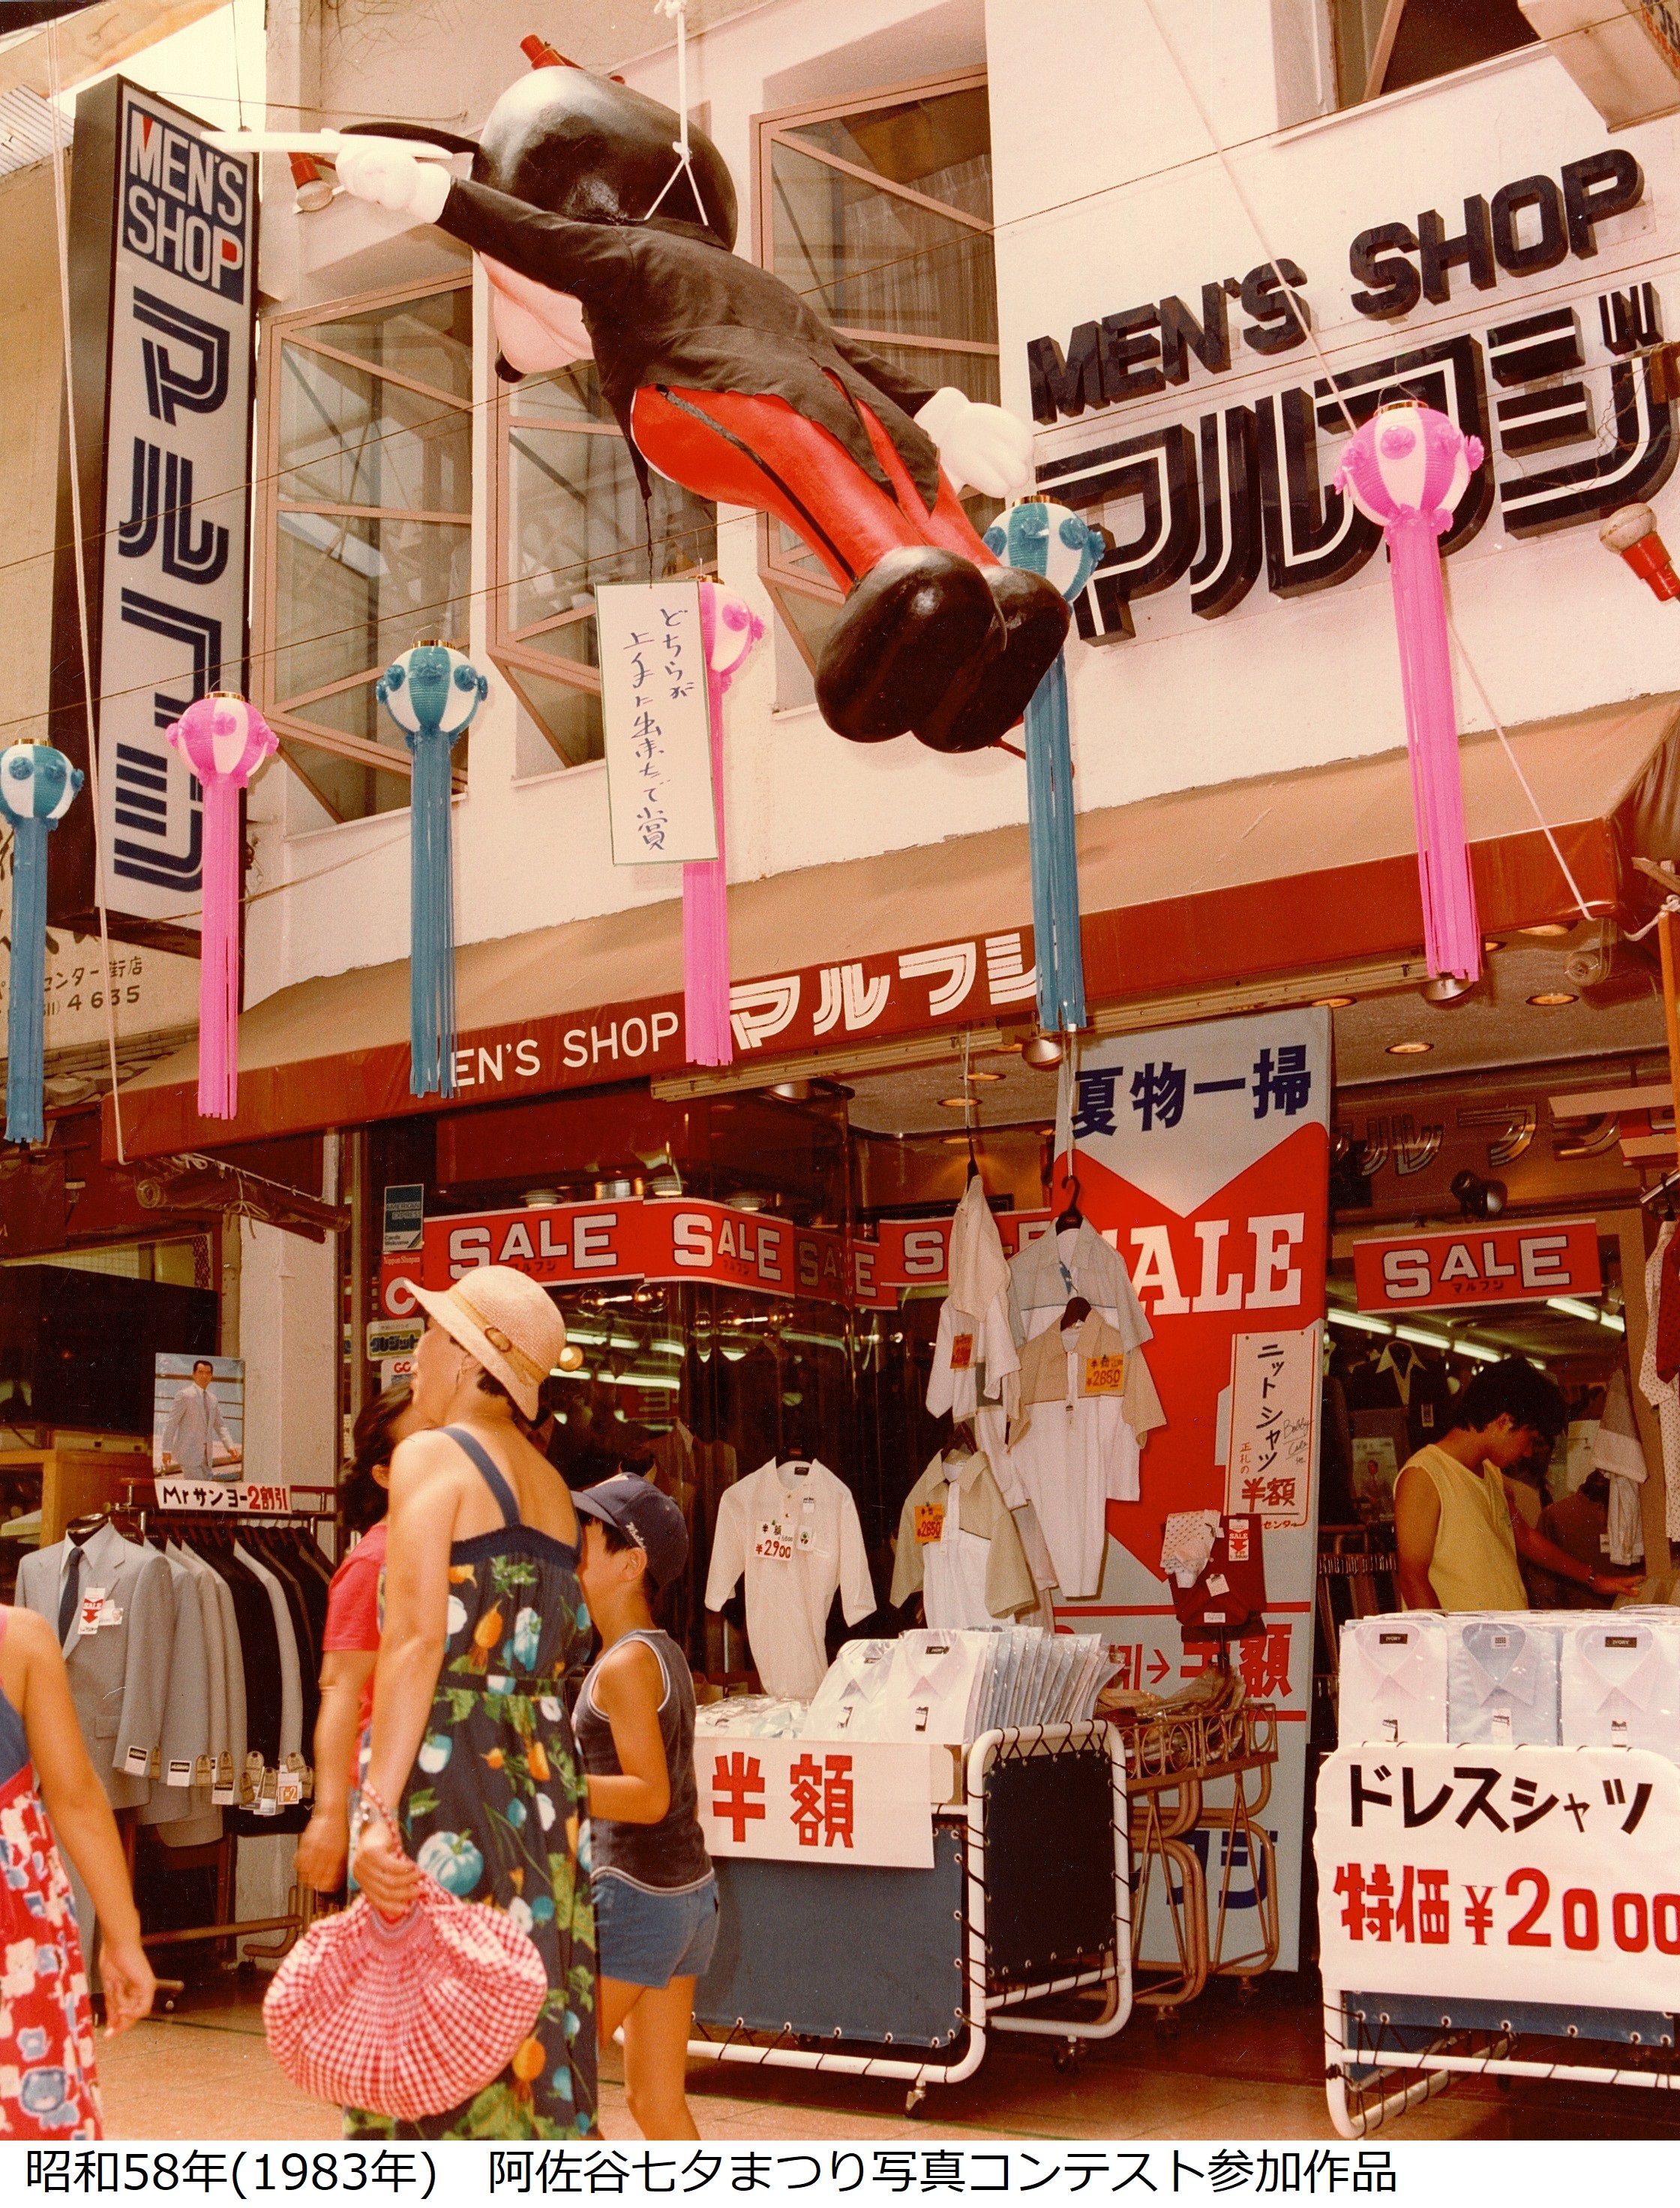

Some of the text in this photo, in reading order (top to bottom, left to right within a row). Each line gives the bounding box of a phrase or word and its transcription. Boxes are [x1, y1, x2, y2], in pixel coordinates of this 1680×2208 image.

[130, 115, 244, 225] MEN'S
[128, 184, 244, 288] SHOP
[1028, 148, 1644, 424] MEN'S SHOP
[1034, 282, 1680, 646] マルフジ
[114, 286, 230, 892] マルフジ
[661, 608, 694, 699] どちらが
[423, 1040, 540, 1088] EN'S
[562, 1011, 679, 1068] SHOP
[1071, 1044, 1311, 1138] 夏物一掃
[450, 1214, 616, 1280] SALE
[674, 1214, 782, 1281] SALE
[1101, 1212, 1305, 1316] ALE
[1383, 1235, 1570, 1300] SALE
[1256, 1344, 1284, 1472] ニットシャツ
[1242, 1477, 1296, 1513] 半額
[712, 1752, 854, 1849] 半額
[1350, 1765, 1653, 1834] ドレスシャツ
